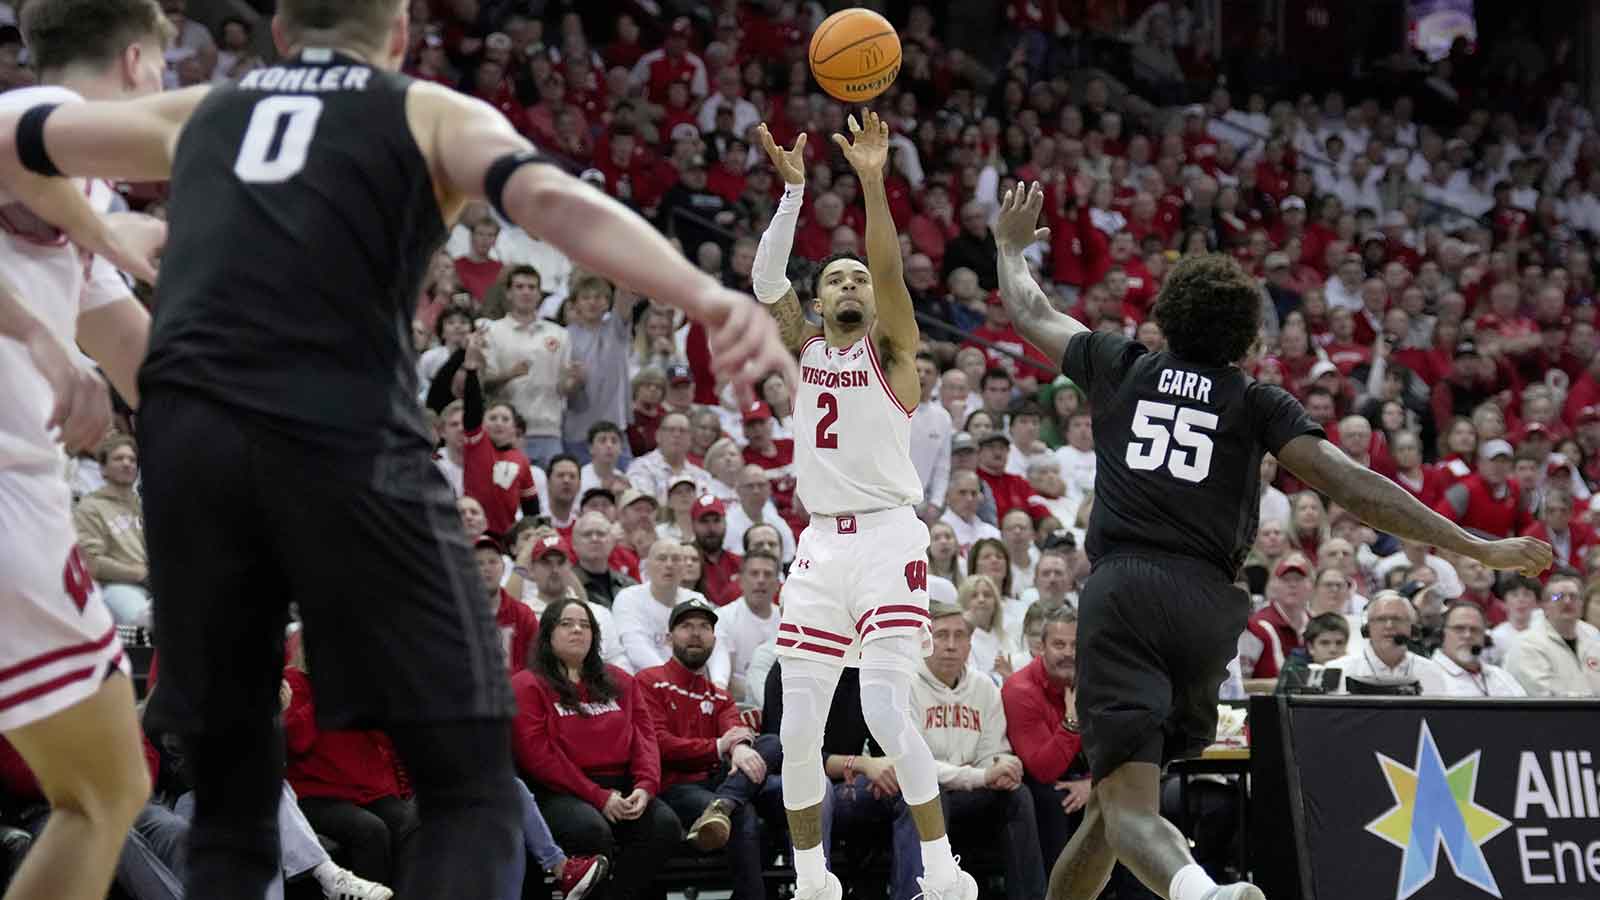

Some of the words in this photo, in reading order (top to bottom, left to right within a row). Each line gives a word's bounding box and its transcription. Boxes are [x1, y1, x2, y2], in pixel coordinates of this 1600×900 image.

[239, 66, 371, 91] KOHLER
[234, 95, 323, 182] 0
[802, 366, 868, 388] WISCONSIN
[1158, 369, 1212, 403] CARR
[816, 392, 838, 449] 2
[1126, 399, 1219, 482] 55
[904, 560, 927, 592] W
[1514, 751, 1600, 818] Alli
